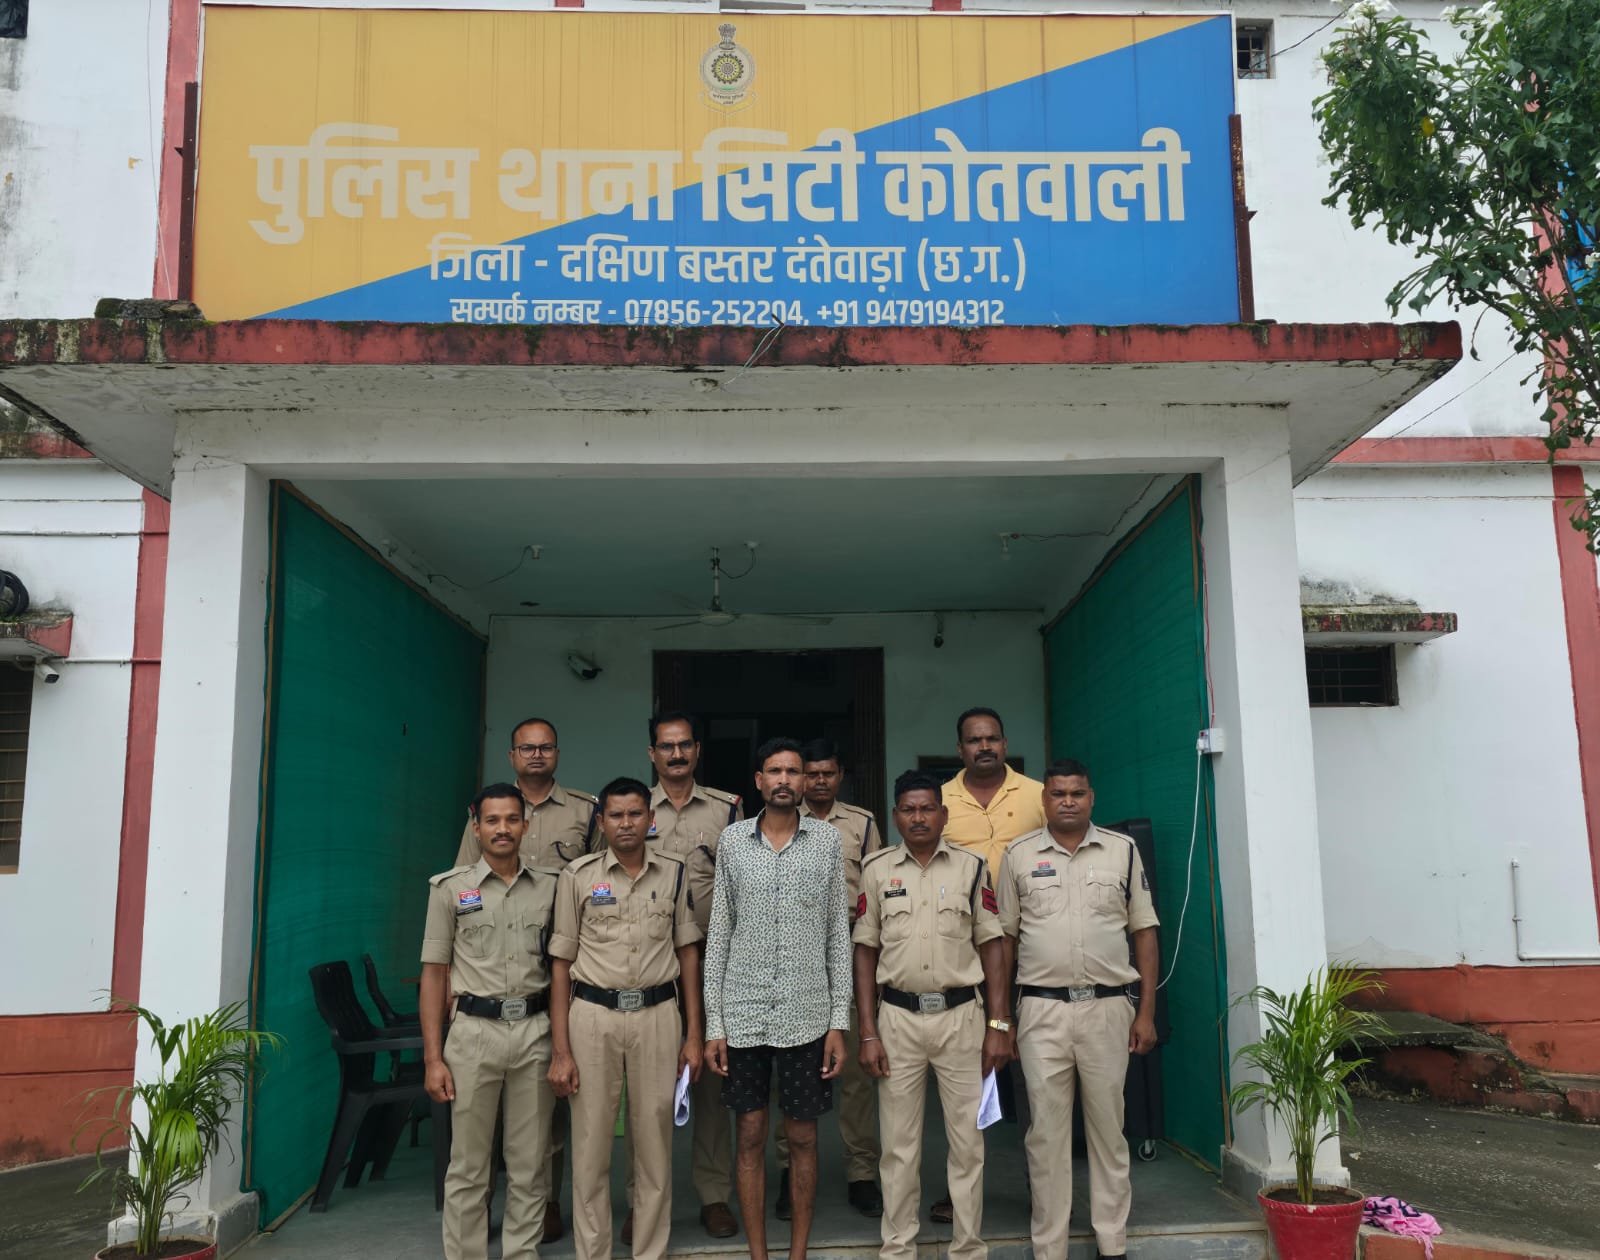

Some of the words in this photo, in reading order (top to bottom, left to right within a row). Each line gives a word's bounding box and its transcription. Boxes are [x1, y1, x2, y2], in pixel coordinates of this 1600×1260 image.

[249, 122, 480, 245] पुलिस
[498, 147, 683, 221] थाना
[693, 127, 866, 223] सिटी
[876, 127, 1192, 223] कोतवाली
[428, 231, 526, 282] जिला
[558, 233, 669, 283] दक्षिण
[675, 246, 777, 284] बस्तर
[782, 234, 906, 292] दंतेवाड़ा
[917, 238, 1027, 292] (छ.ग.)
[449, 291, 528, 324] सम्पर्क
[531, 299, 602, 324] नम्बर
[816, 300, 859, 325] +91
[866, 300, 1005, 325] 9479194312
